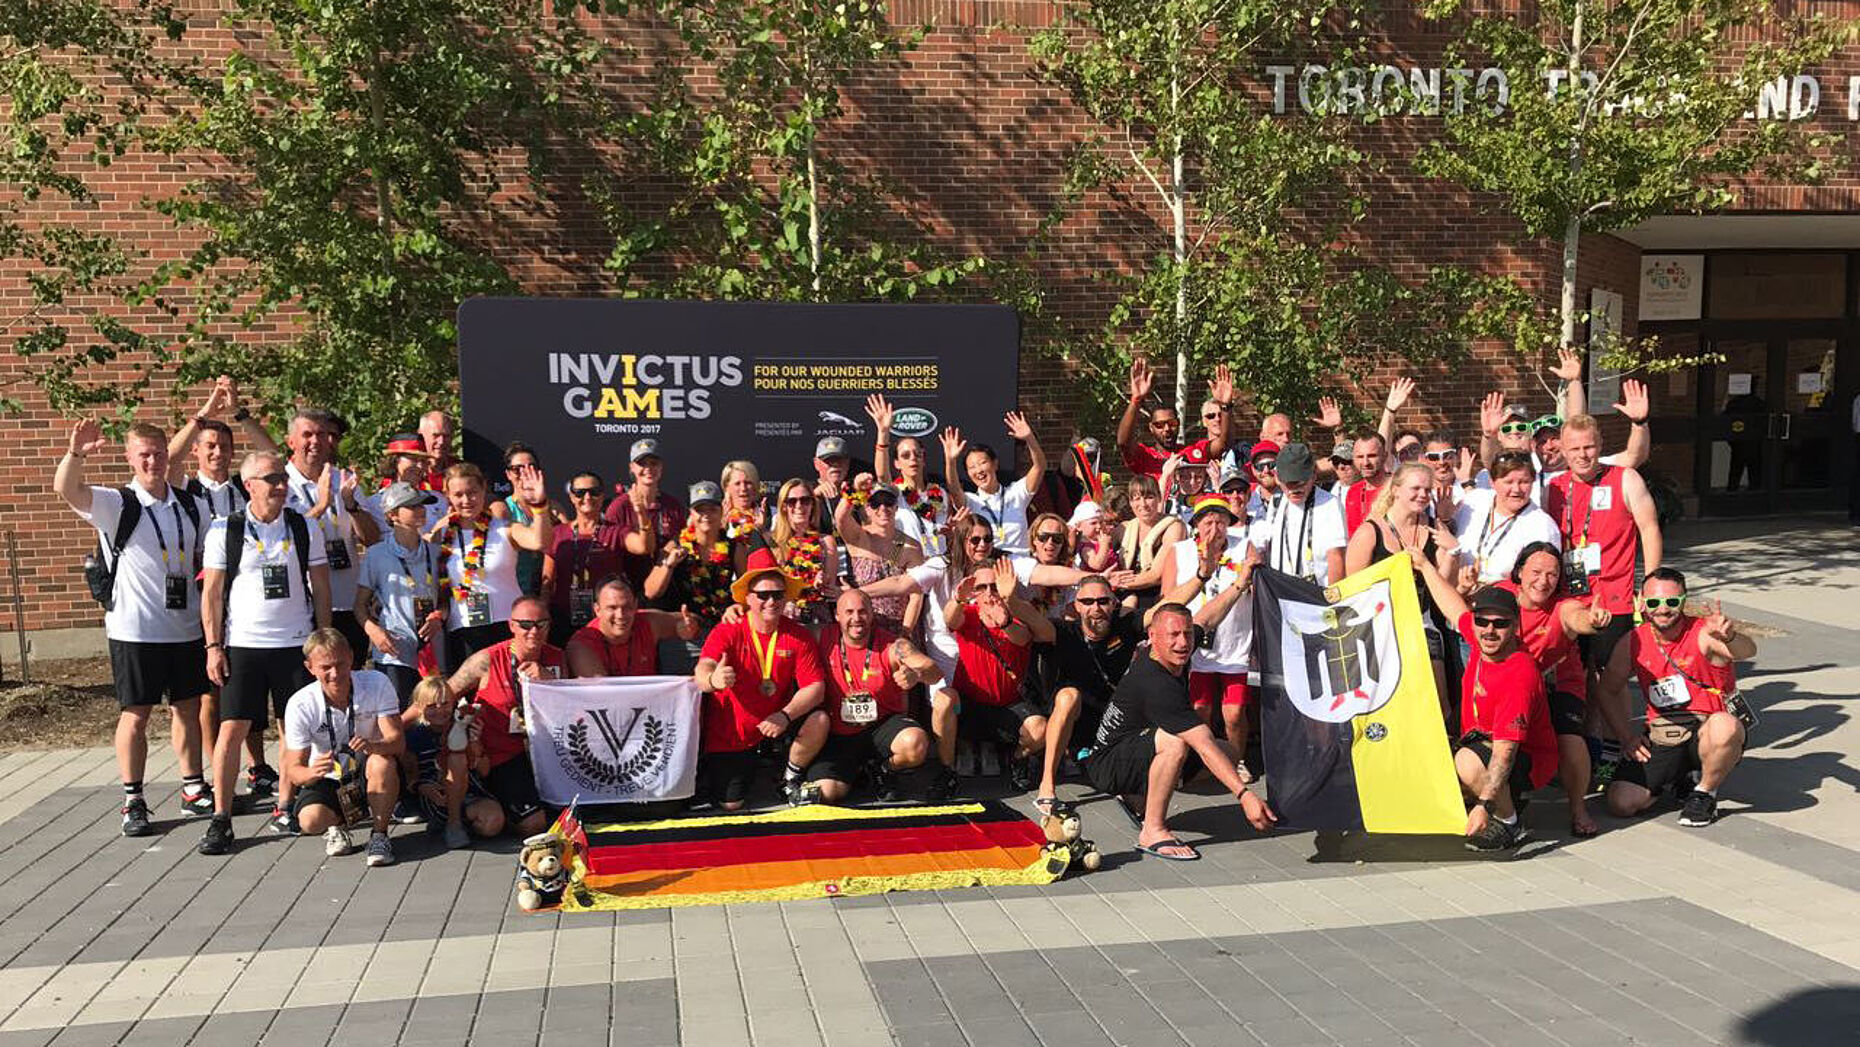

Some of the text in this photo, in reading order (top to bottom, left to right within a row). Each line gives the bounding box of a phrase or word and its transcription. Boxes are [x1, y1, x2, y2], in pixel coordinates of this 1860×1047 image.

[1266, 63, 1508, 117] TORONTO
[1743, 75, 1820, 120] ND
[549, 353, 743, 387] INVICTUS
[754, 365, 938, 377] FOR OUR WOUNDED WARRIORS
[754, 379, 787, 389] POUR
[790, 379, 814, 389] NOS
[818, 379, 884, 389] GUERRIERS
[563, 387, 712, 420] GAMES
[594, 424, 661, 434] TORONTO 2017
[849, 704, 870, 714] 189
[560, 758, 604, 793] GEDIENT
